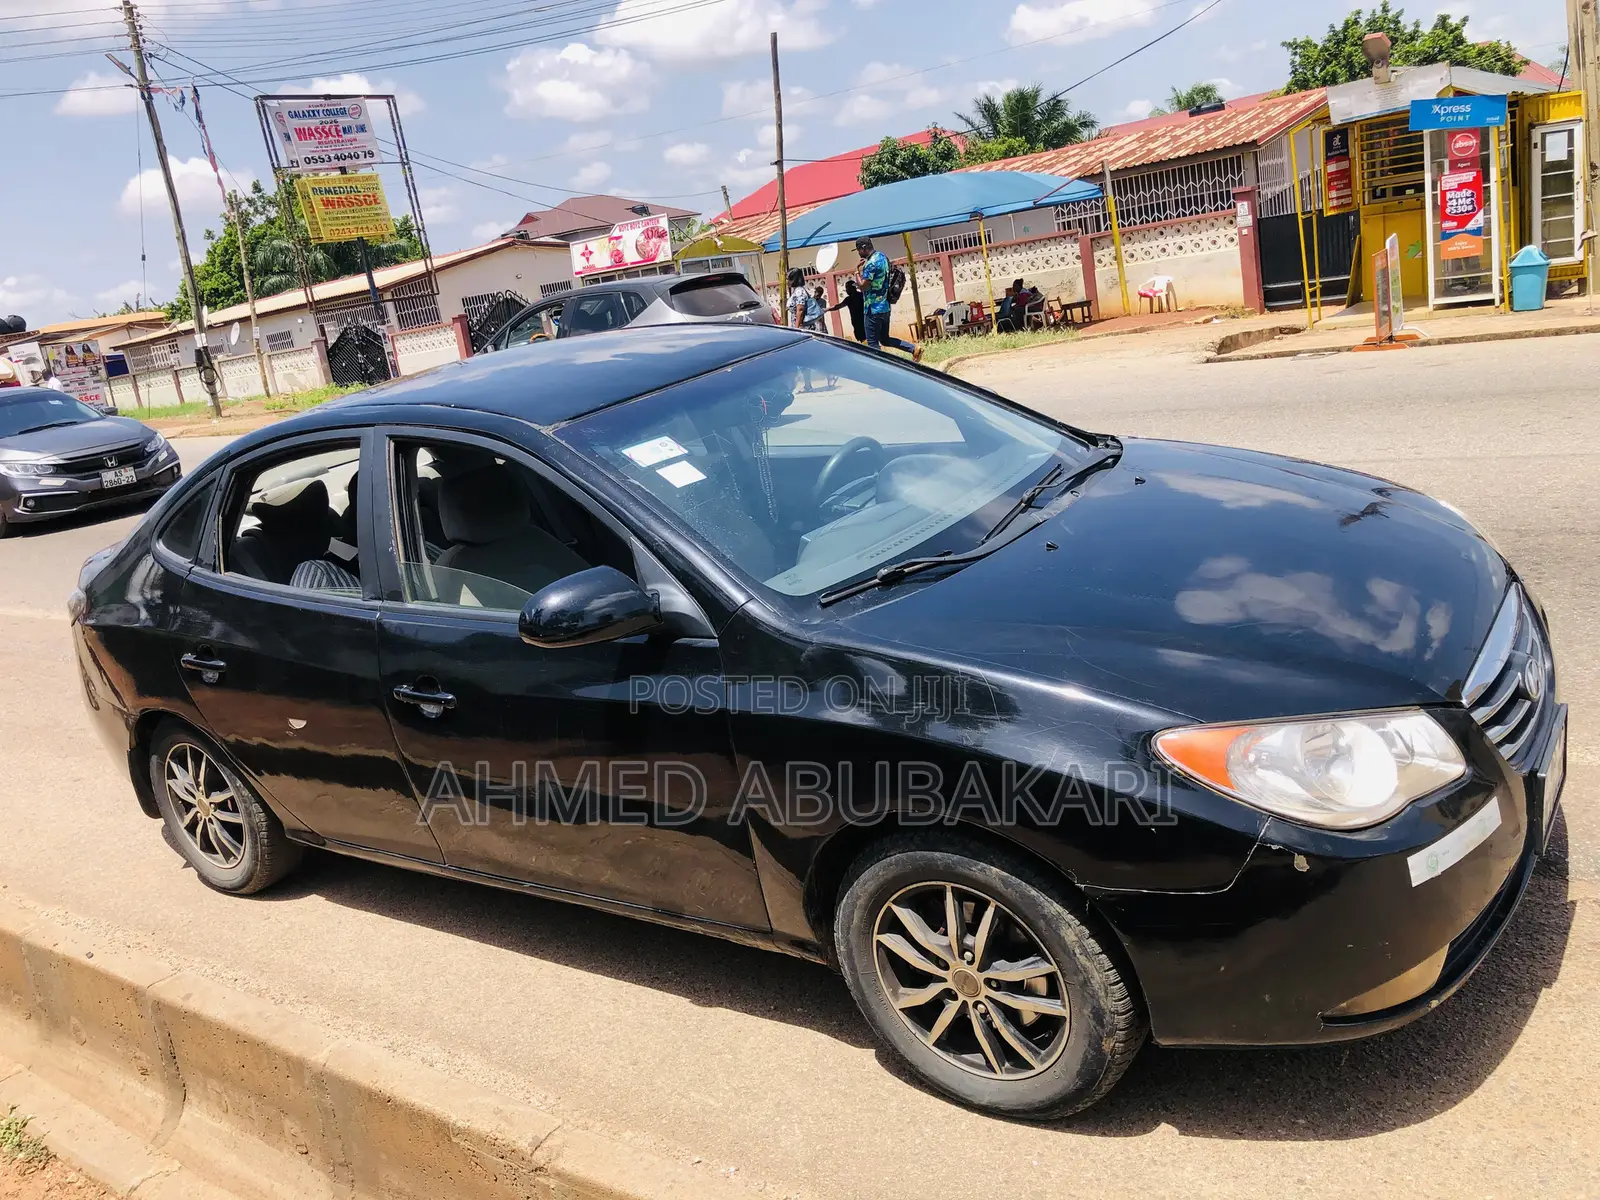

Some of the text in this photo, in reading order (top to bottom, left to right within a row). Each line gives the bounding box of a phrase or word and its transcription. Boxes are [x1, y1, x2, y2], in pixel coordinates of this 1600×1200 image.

[287, 109, 320, 119] GALAXXY
[321, 107, 347, 117] COLLEGE
[1431, 103, 1472, 116] Xpress
[1440, 114, 1471, 123] POINT
[294, 124, 343, 142] WASSCE
[317, 137, 358, 146] REGISTRATION
[303, 153, 332, 165] 0553
[333, 151, 360, 161] 4040
[361, 149, 375, 159] 79
[311, 184, 361, 196] REMEDIAL
[1446, 190, 1473, 199] Made
[320, 193, 381, 209] WASSCE
[79, 394, 101, 402] SSCE
[114, 470, 123, 478] AS
[104, 475, 134, 487] 2860-22
